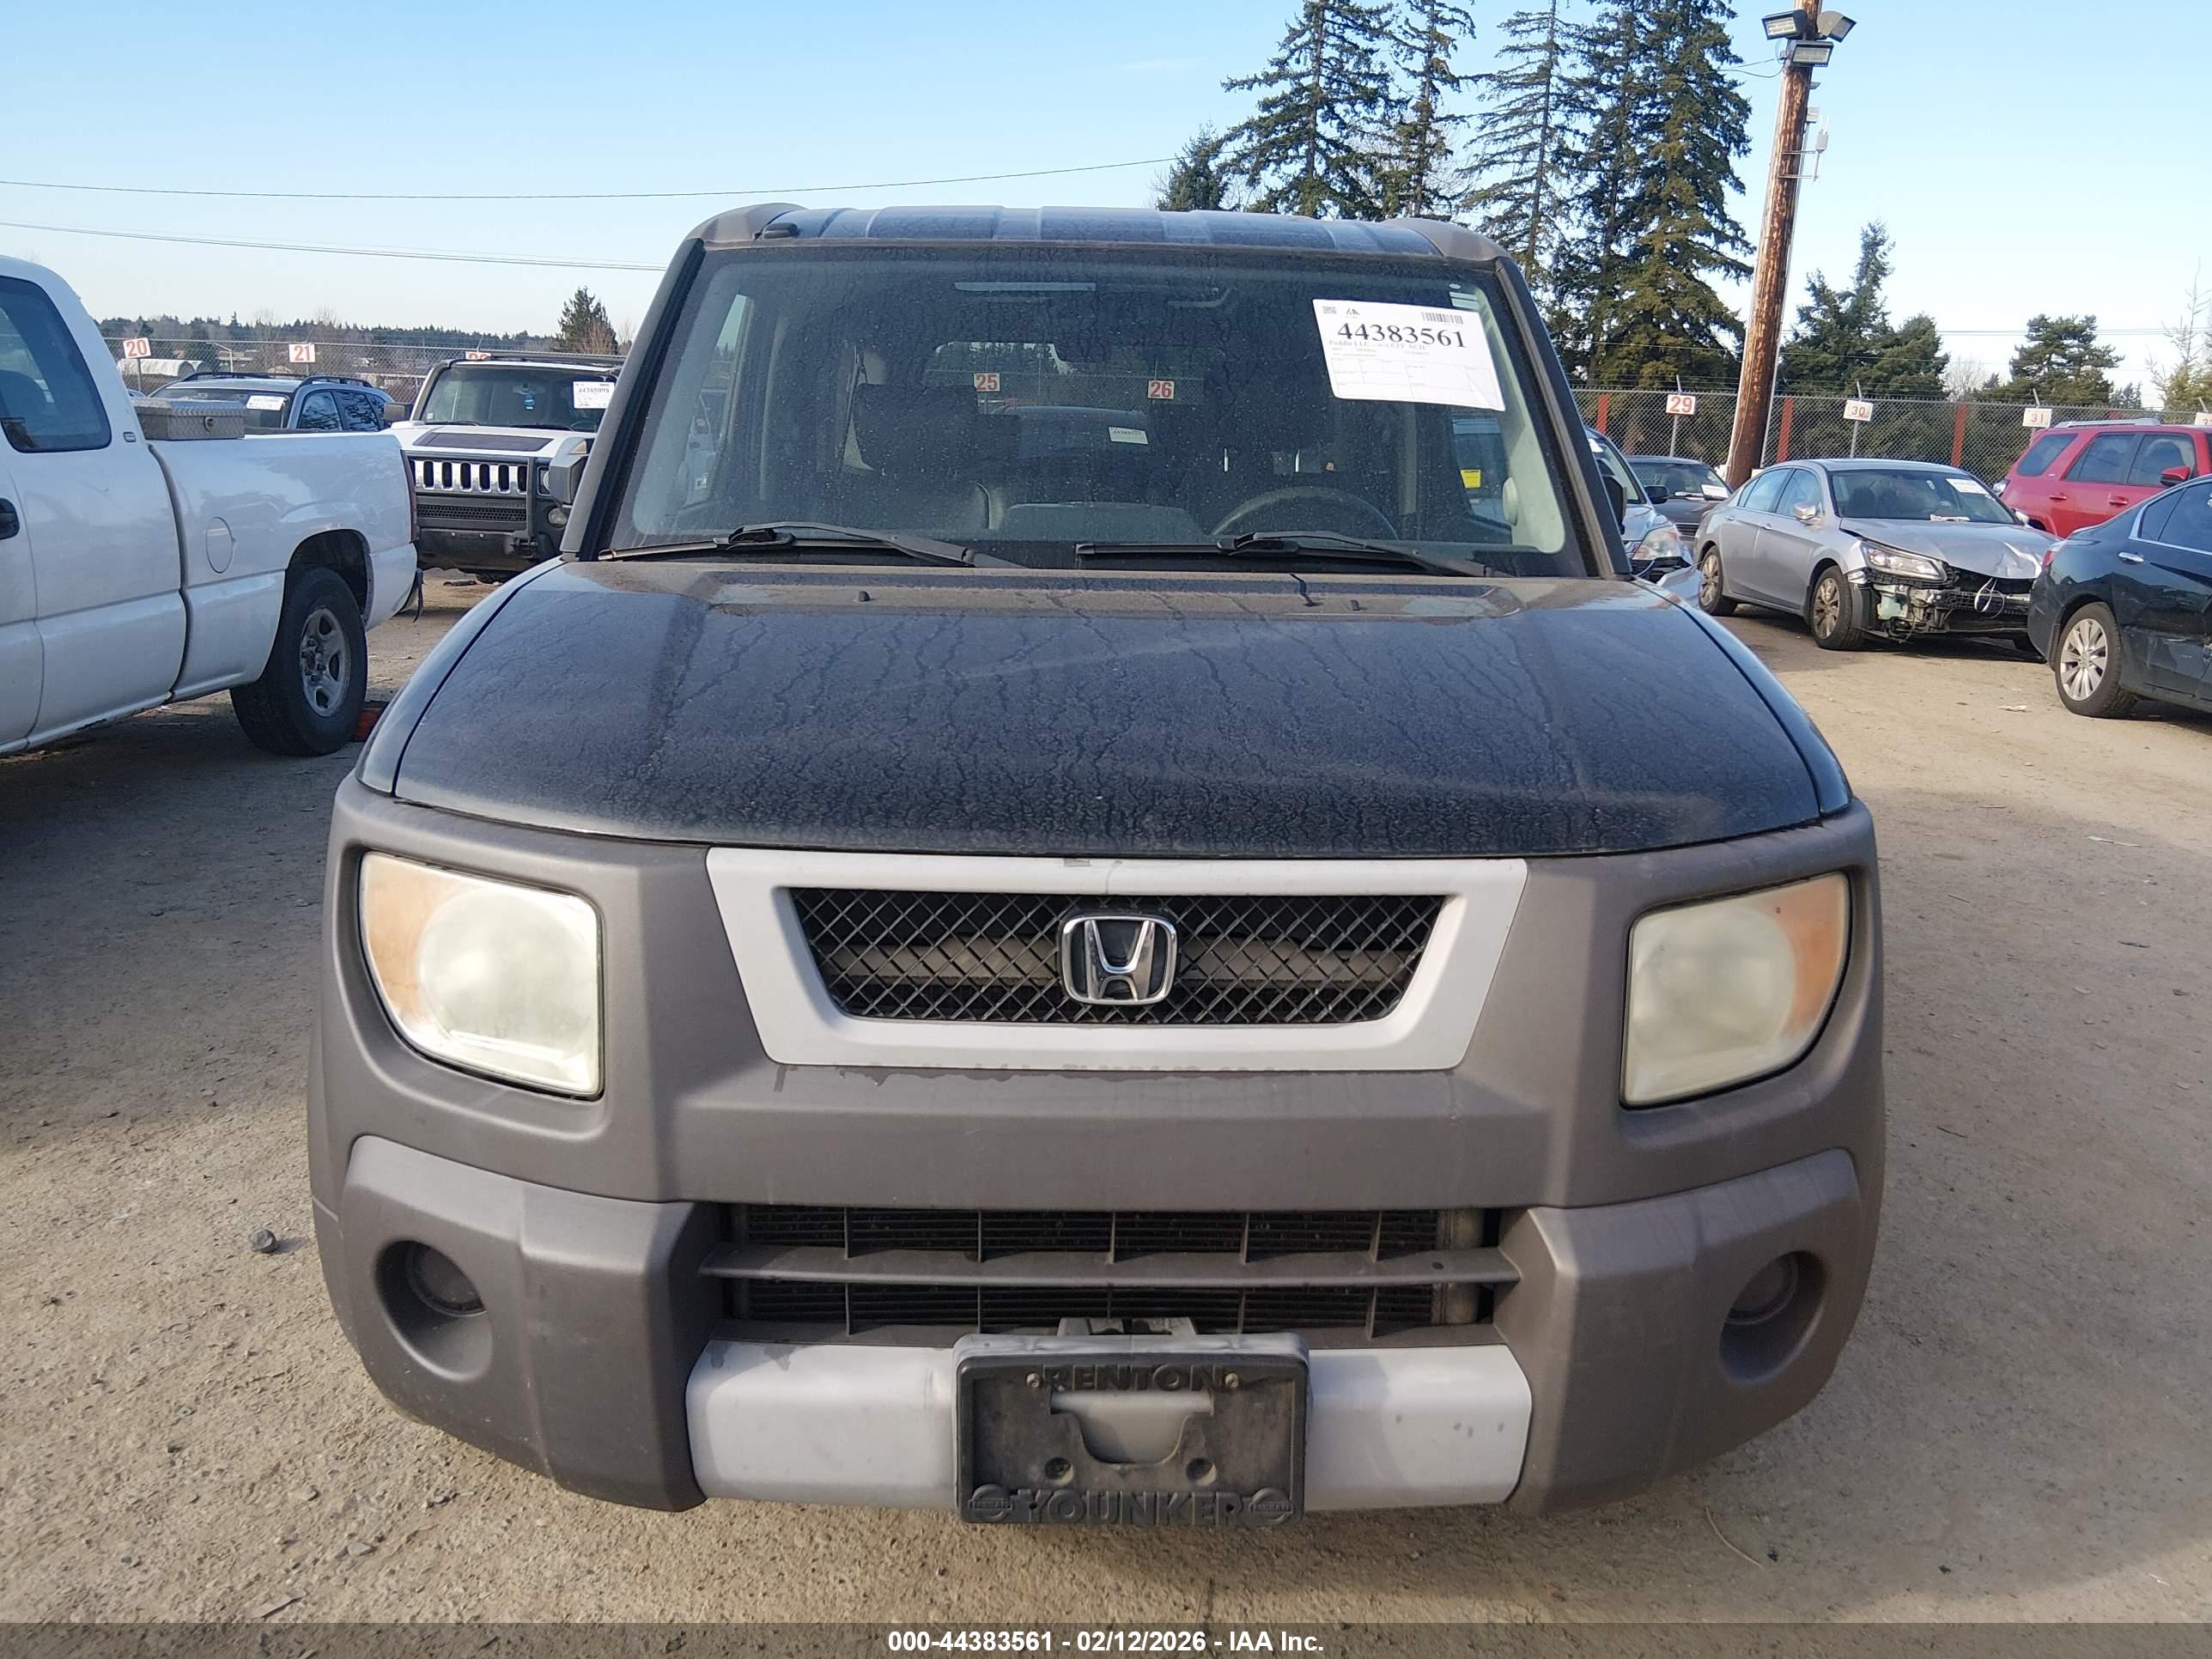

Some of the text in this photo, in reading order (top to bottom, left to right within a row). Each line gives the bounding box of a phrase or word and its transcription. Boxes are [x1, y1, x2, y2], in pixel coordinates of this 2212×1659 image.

[1338, 322, 1466, 348] 44383561
[126, 340, 149, 357] 20
[295, 345, 311, 361] 21
[976, 374, 998, 390] 25
[1151, 381, 1172, 398] 26
[1670, 396, 1692, 413] 29
[1851, 406, 1866, 416] 30
[2031, 413, 2044, 424] 31
[1042, 1363, 1224, 1391] RENTON
[1017, 1487, 1243, 1526] YOUNKER
